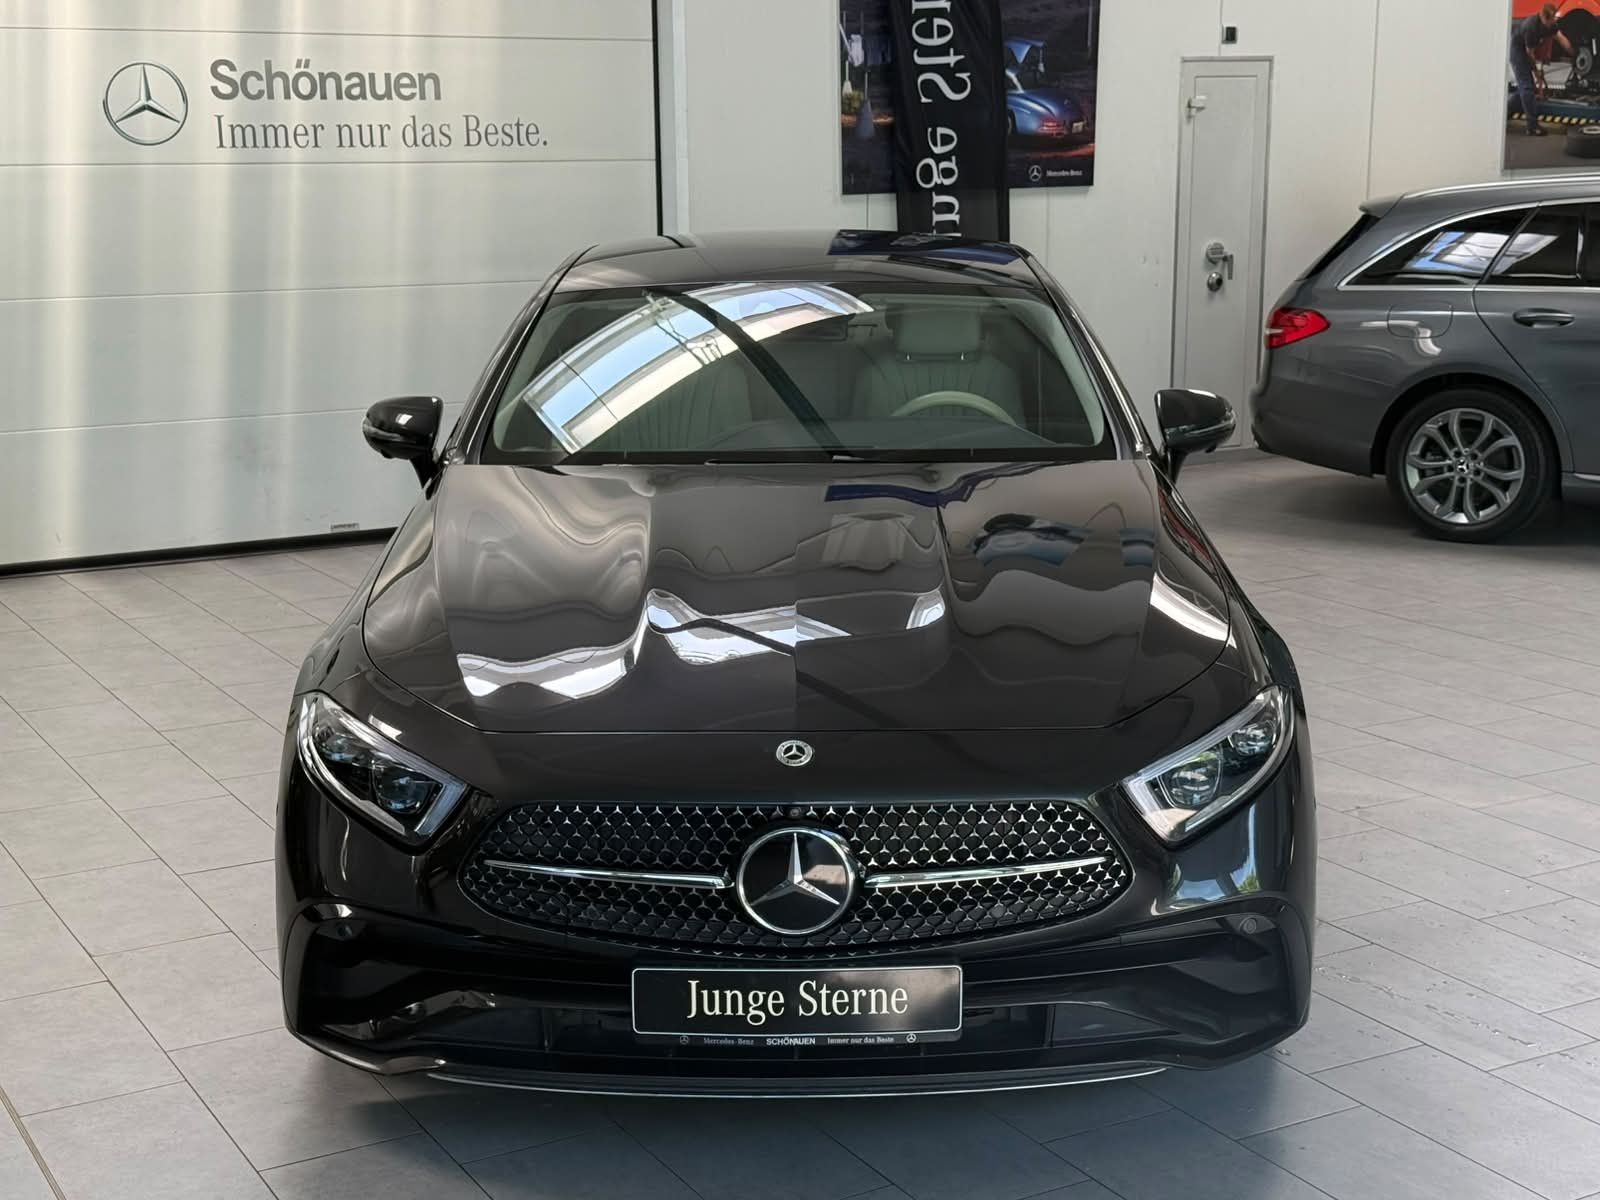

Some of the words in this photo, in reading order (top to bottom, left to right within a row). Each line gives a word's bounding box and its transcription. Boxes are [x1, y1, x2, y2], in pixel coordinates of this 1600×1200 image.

[209, 58, 442, 101] Schönauen
[213, 114, 325, 149] Immer
[335, 123, 392, 149] nur
[401, 115, 453, 148] das
[462, 114, 548, 148] Beste.
[686, 979, 785, 1026] Junge
[798, 979, 909, 1017] Sterne
[765, 1036, 816, 1046] SCHÖNAUEN
